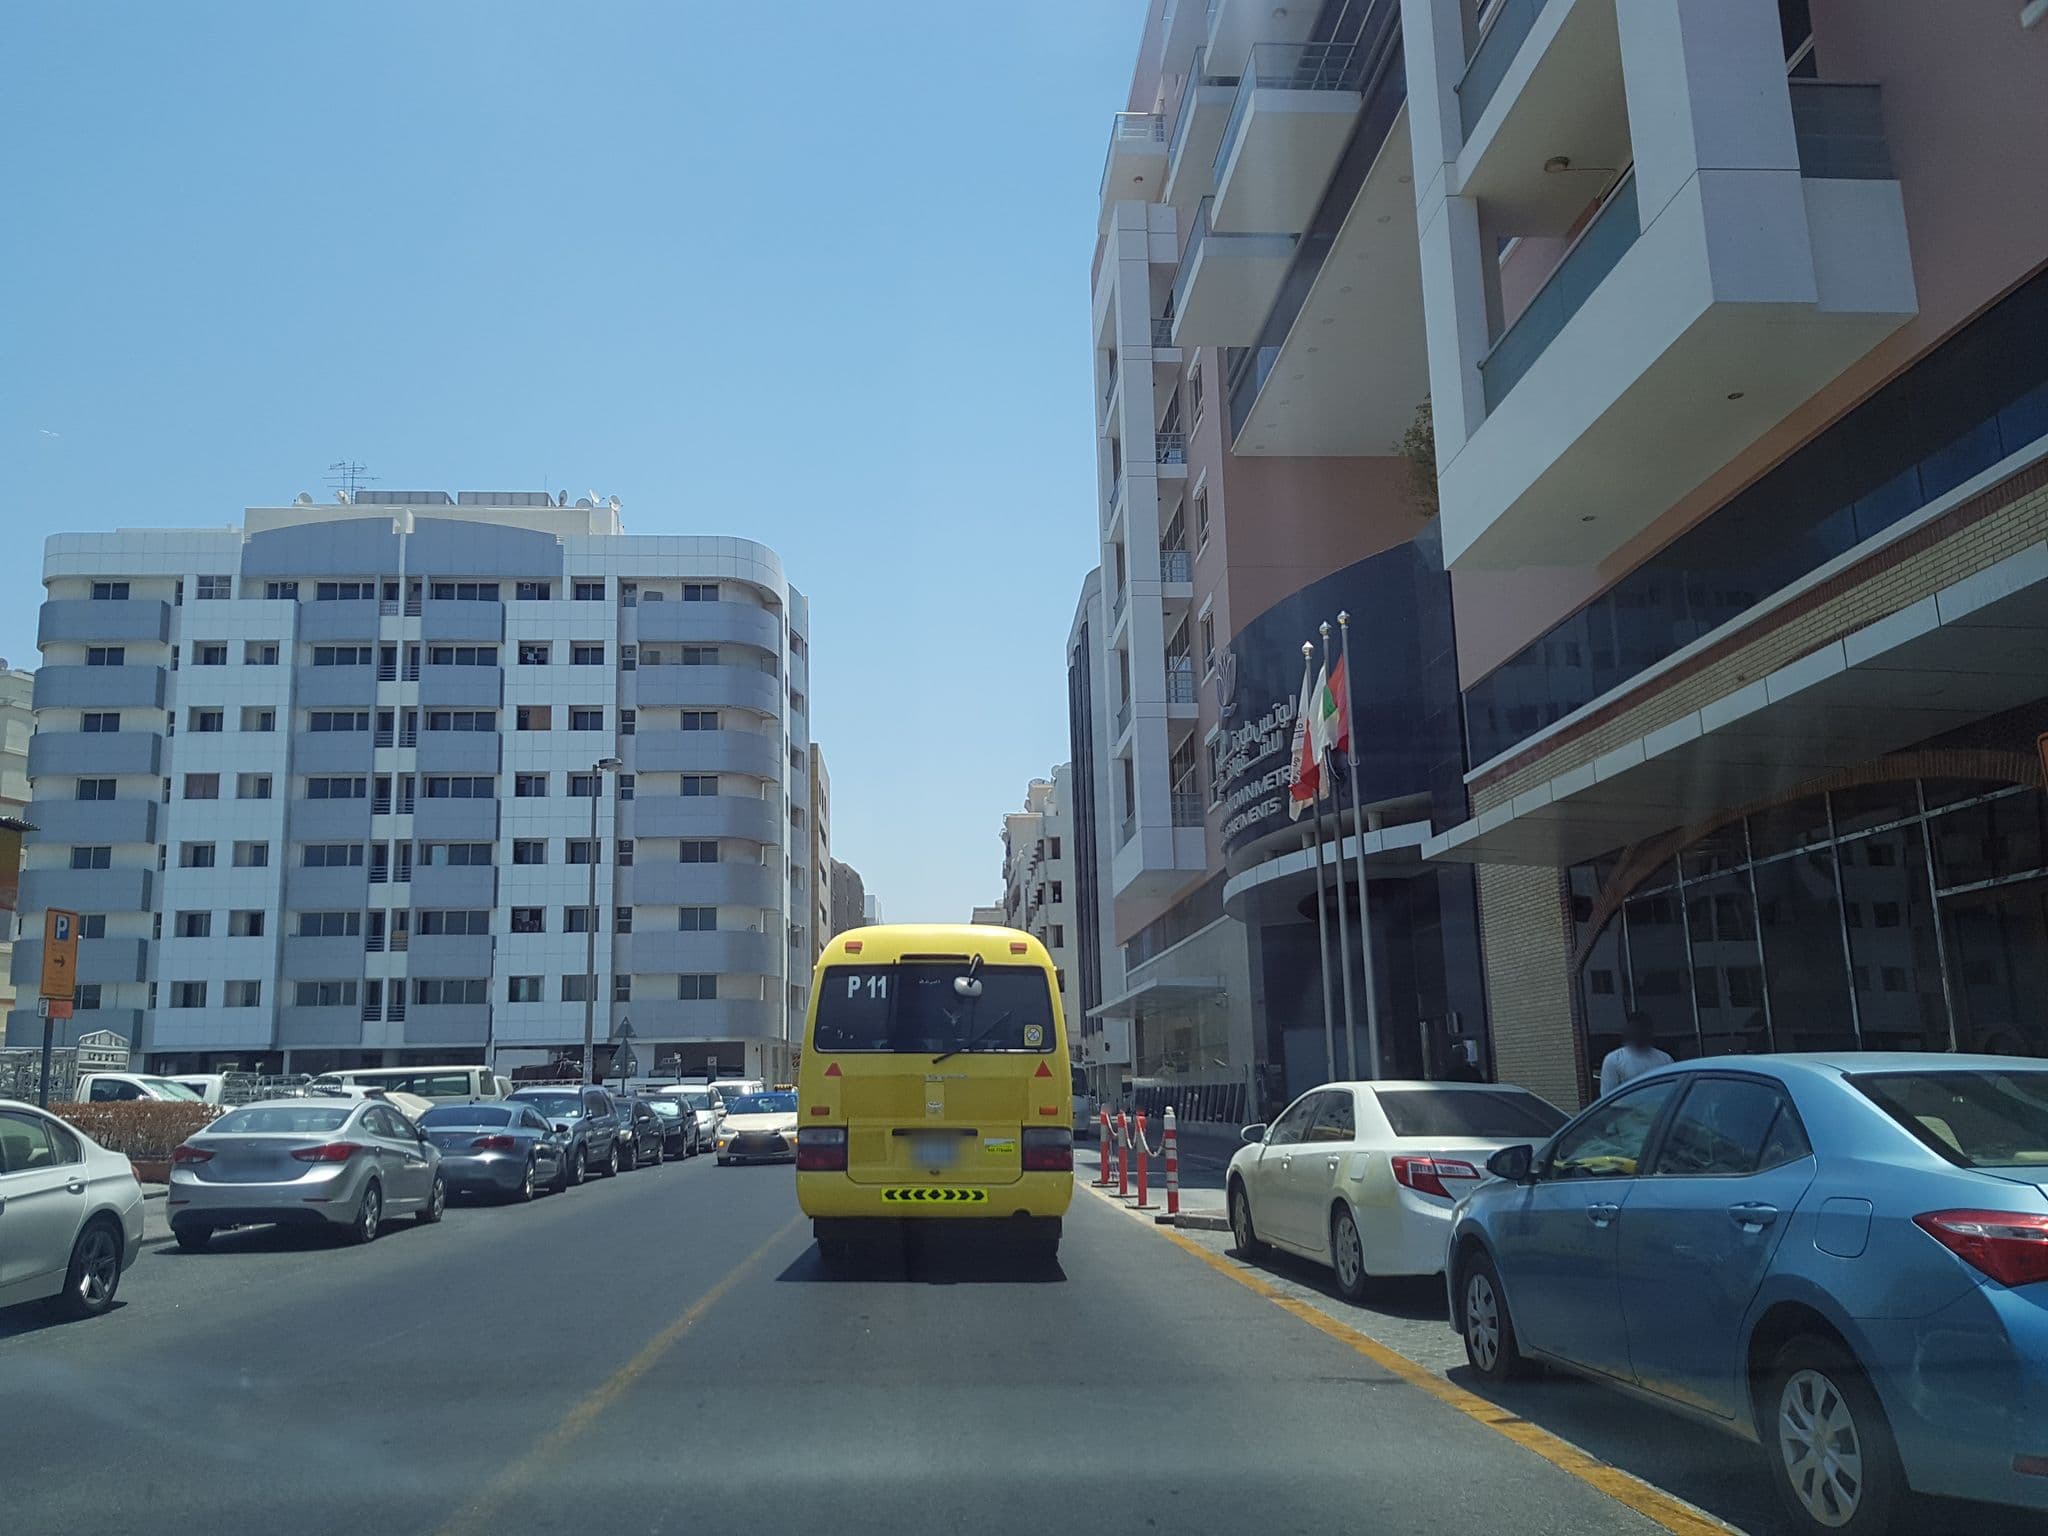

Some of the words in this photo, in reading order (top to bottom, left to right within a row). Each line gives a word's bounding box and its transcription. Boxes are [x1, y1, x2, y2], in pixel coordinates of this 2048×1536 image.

[56, 915, 68, 939] P
[847, 975, 861, 999] P
[867, 975, 887, 999] 11
